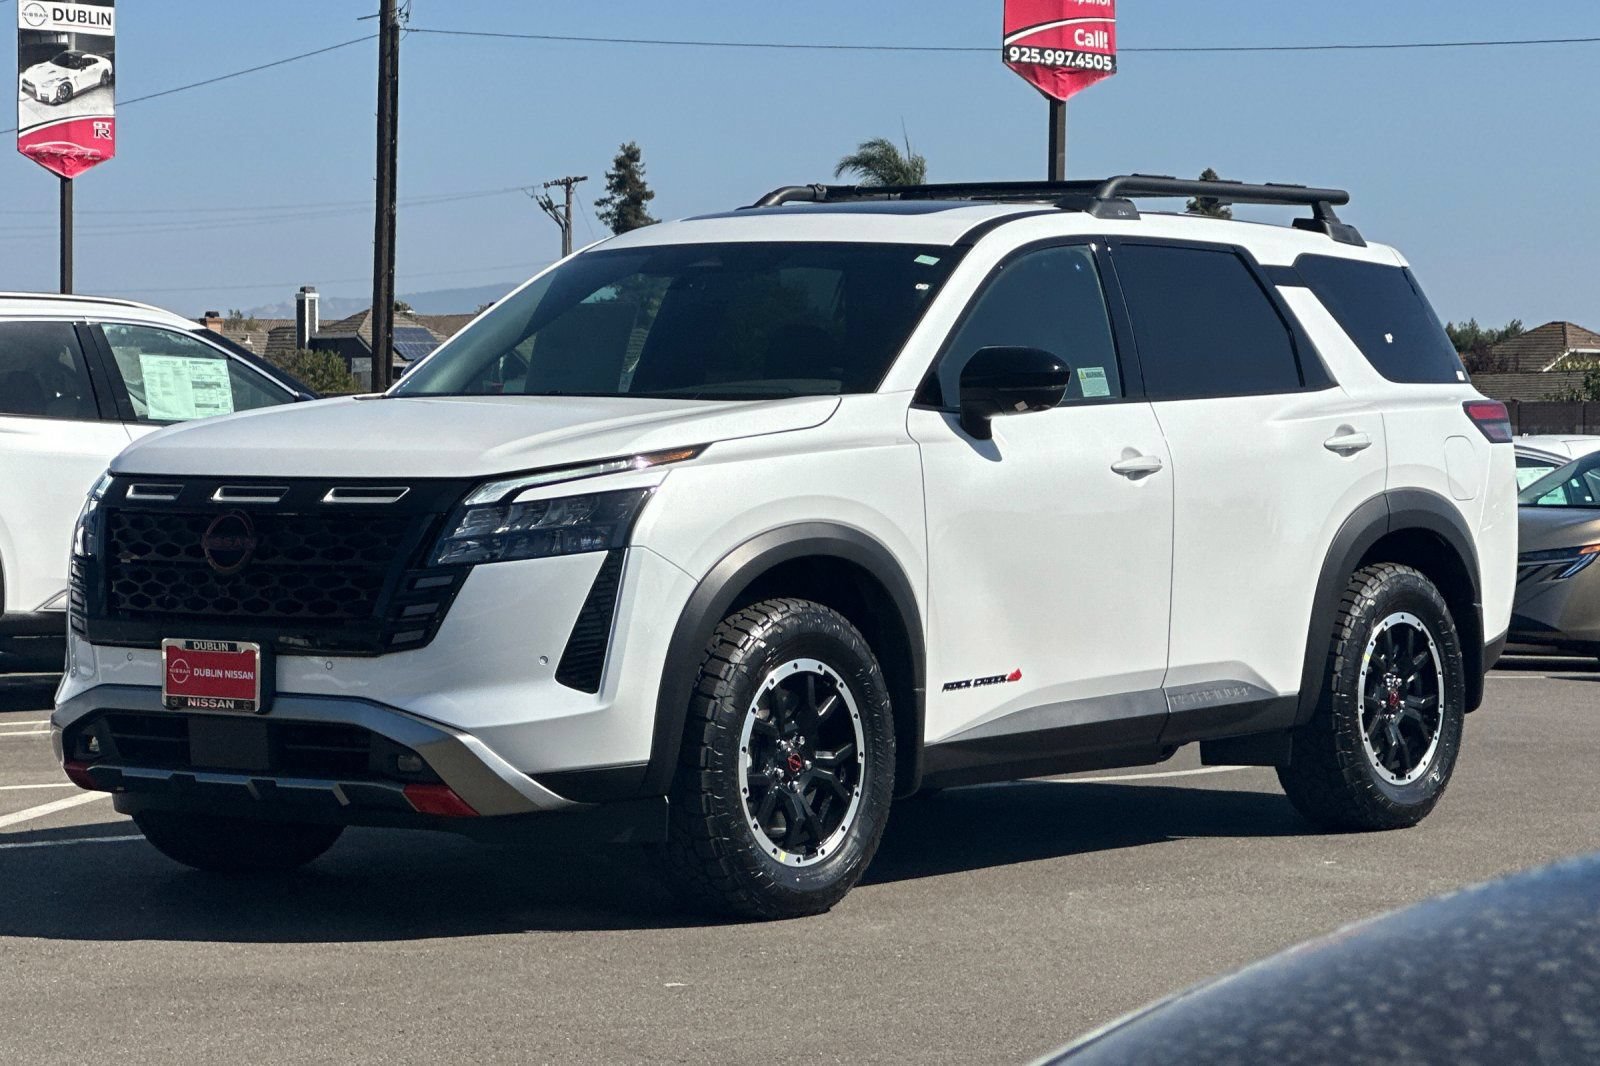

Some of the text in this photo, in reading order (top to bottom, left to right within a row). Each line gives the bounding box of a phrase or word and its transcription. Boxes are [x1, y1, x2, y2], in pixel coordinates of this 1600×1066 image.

[53, 8, 112, 26] DUBLIN
[1074, 28, 1109, 49] Call!
[1009, 47, 1112, 71] 925.997.4505
[193, 641, 229, 651] DUBLIN
[193, 667, 254, 680] DUBLIN NISSAN
[187, 697, 235, 709] NISSAN
